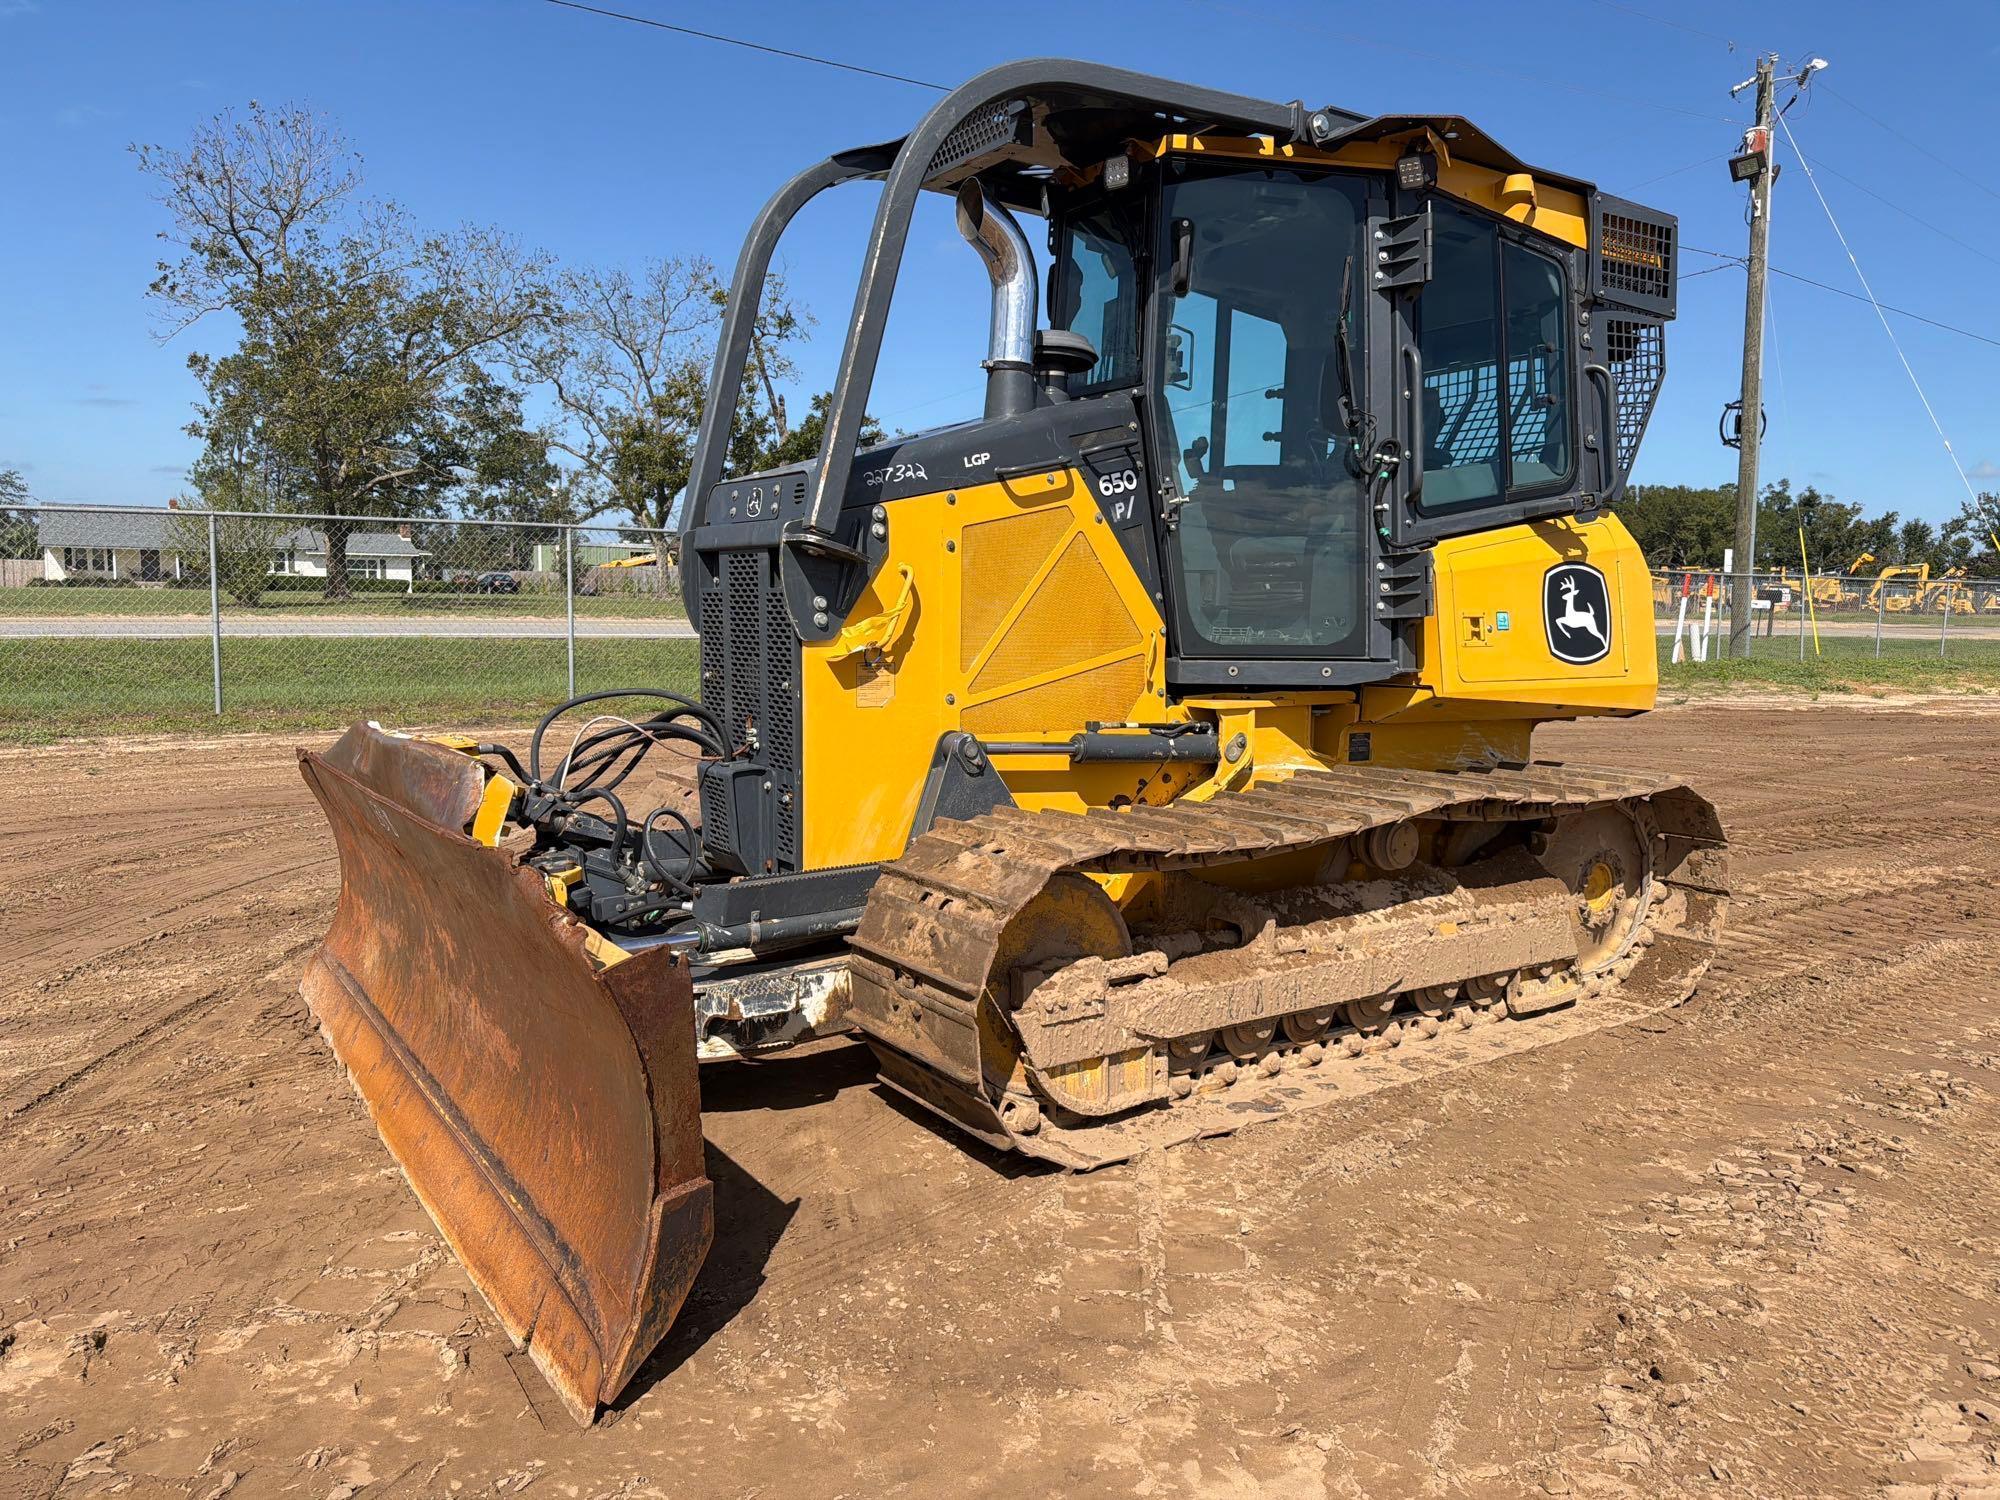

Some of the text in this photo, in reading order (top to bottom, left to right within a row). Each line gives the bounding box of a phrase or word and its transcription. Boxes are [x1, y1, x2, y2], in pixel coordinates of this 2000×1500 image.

[963, 452, 991, 468] LGP
[863, 462, 929, 486] 227322
[1099, 469, 1138, 497] 650
